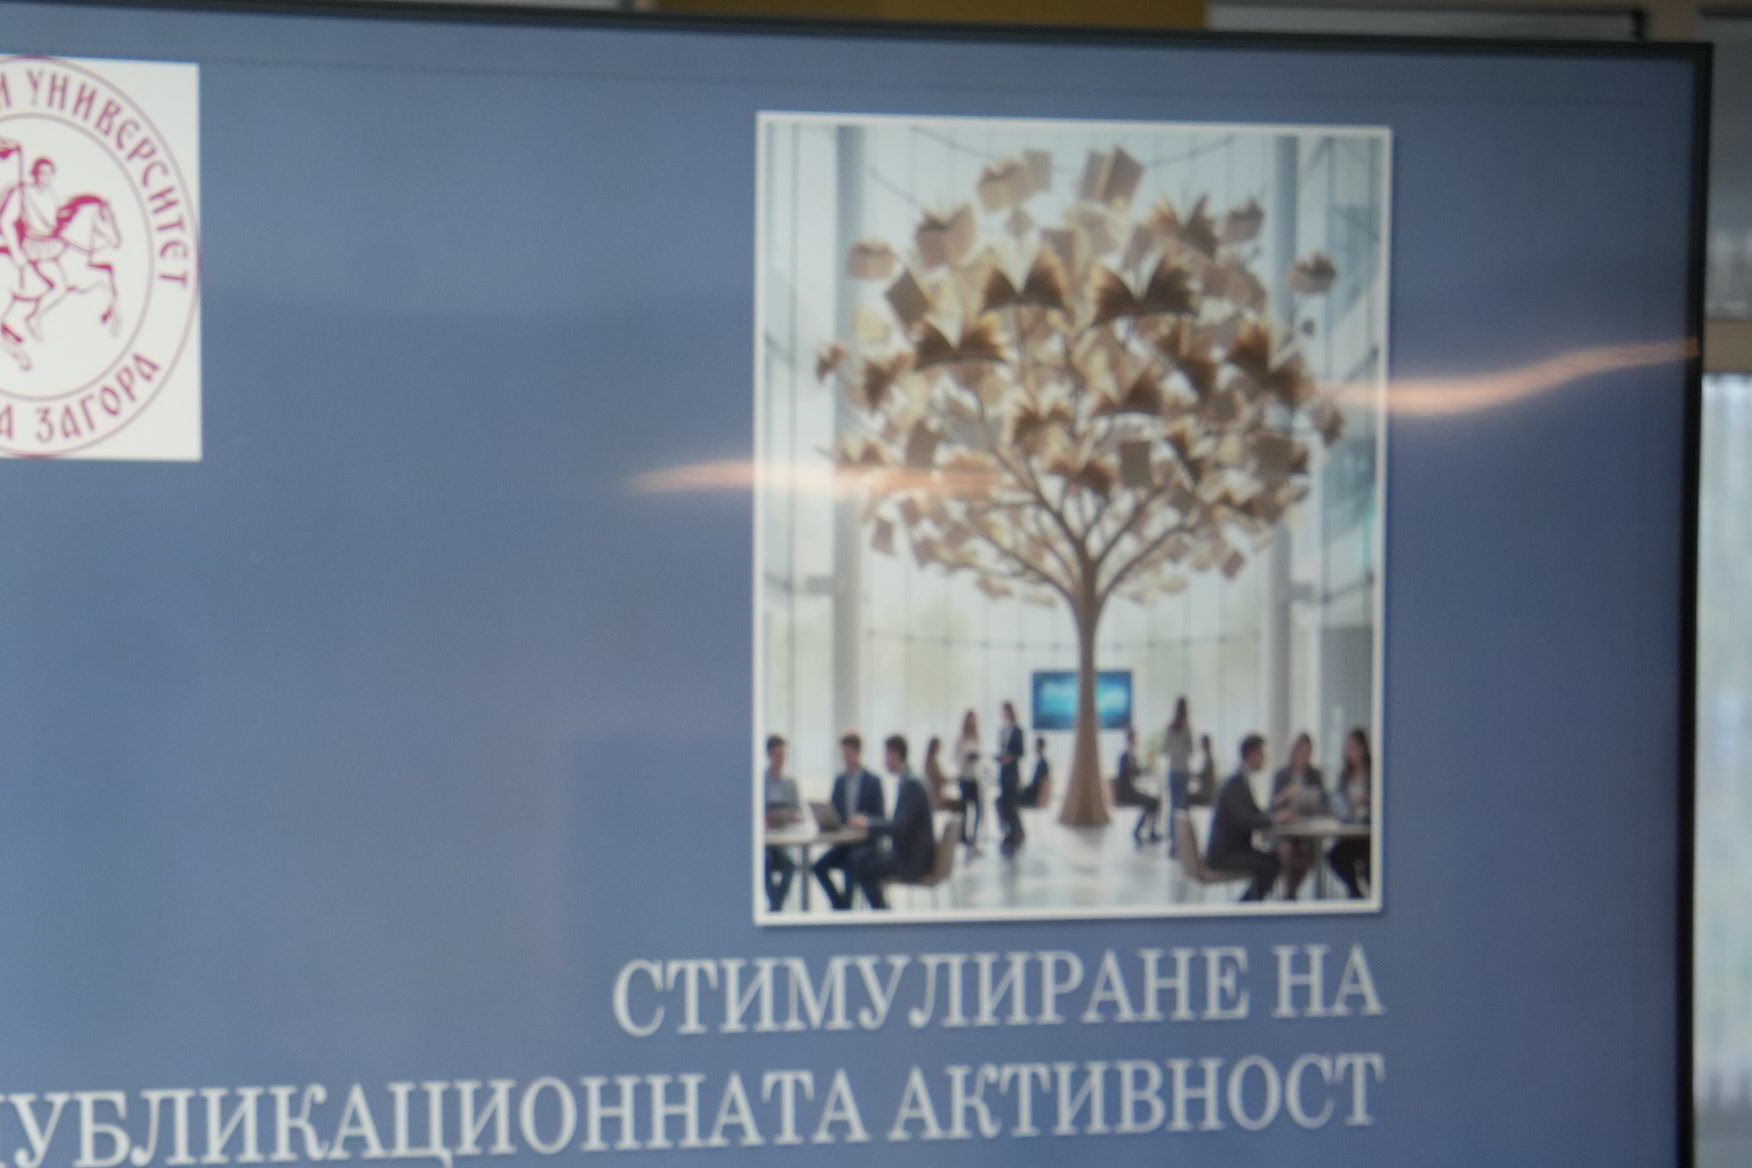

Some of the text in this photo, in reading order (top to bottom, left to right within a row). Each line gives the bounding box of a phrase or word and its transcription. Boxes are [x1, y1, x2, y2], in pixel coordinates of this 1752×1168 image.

[28, 69, 189, 288] УНИВЕРСИТЕТ
[35, 352, 160, 443] ЗАГОРА
[612, 943, 1386, 1036] СТИМУЛИРАНЕ НА
[888, 1053, 1386, 1140] АКТИВНОСТ
